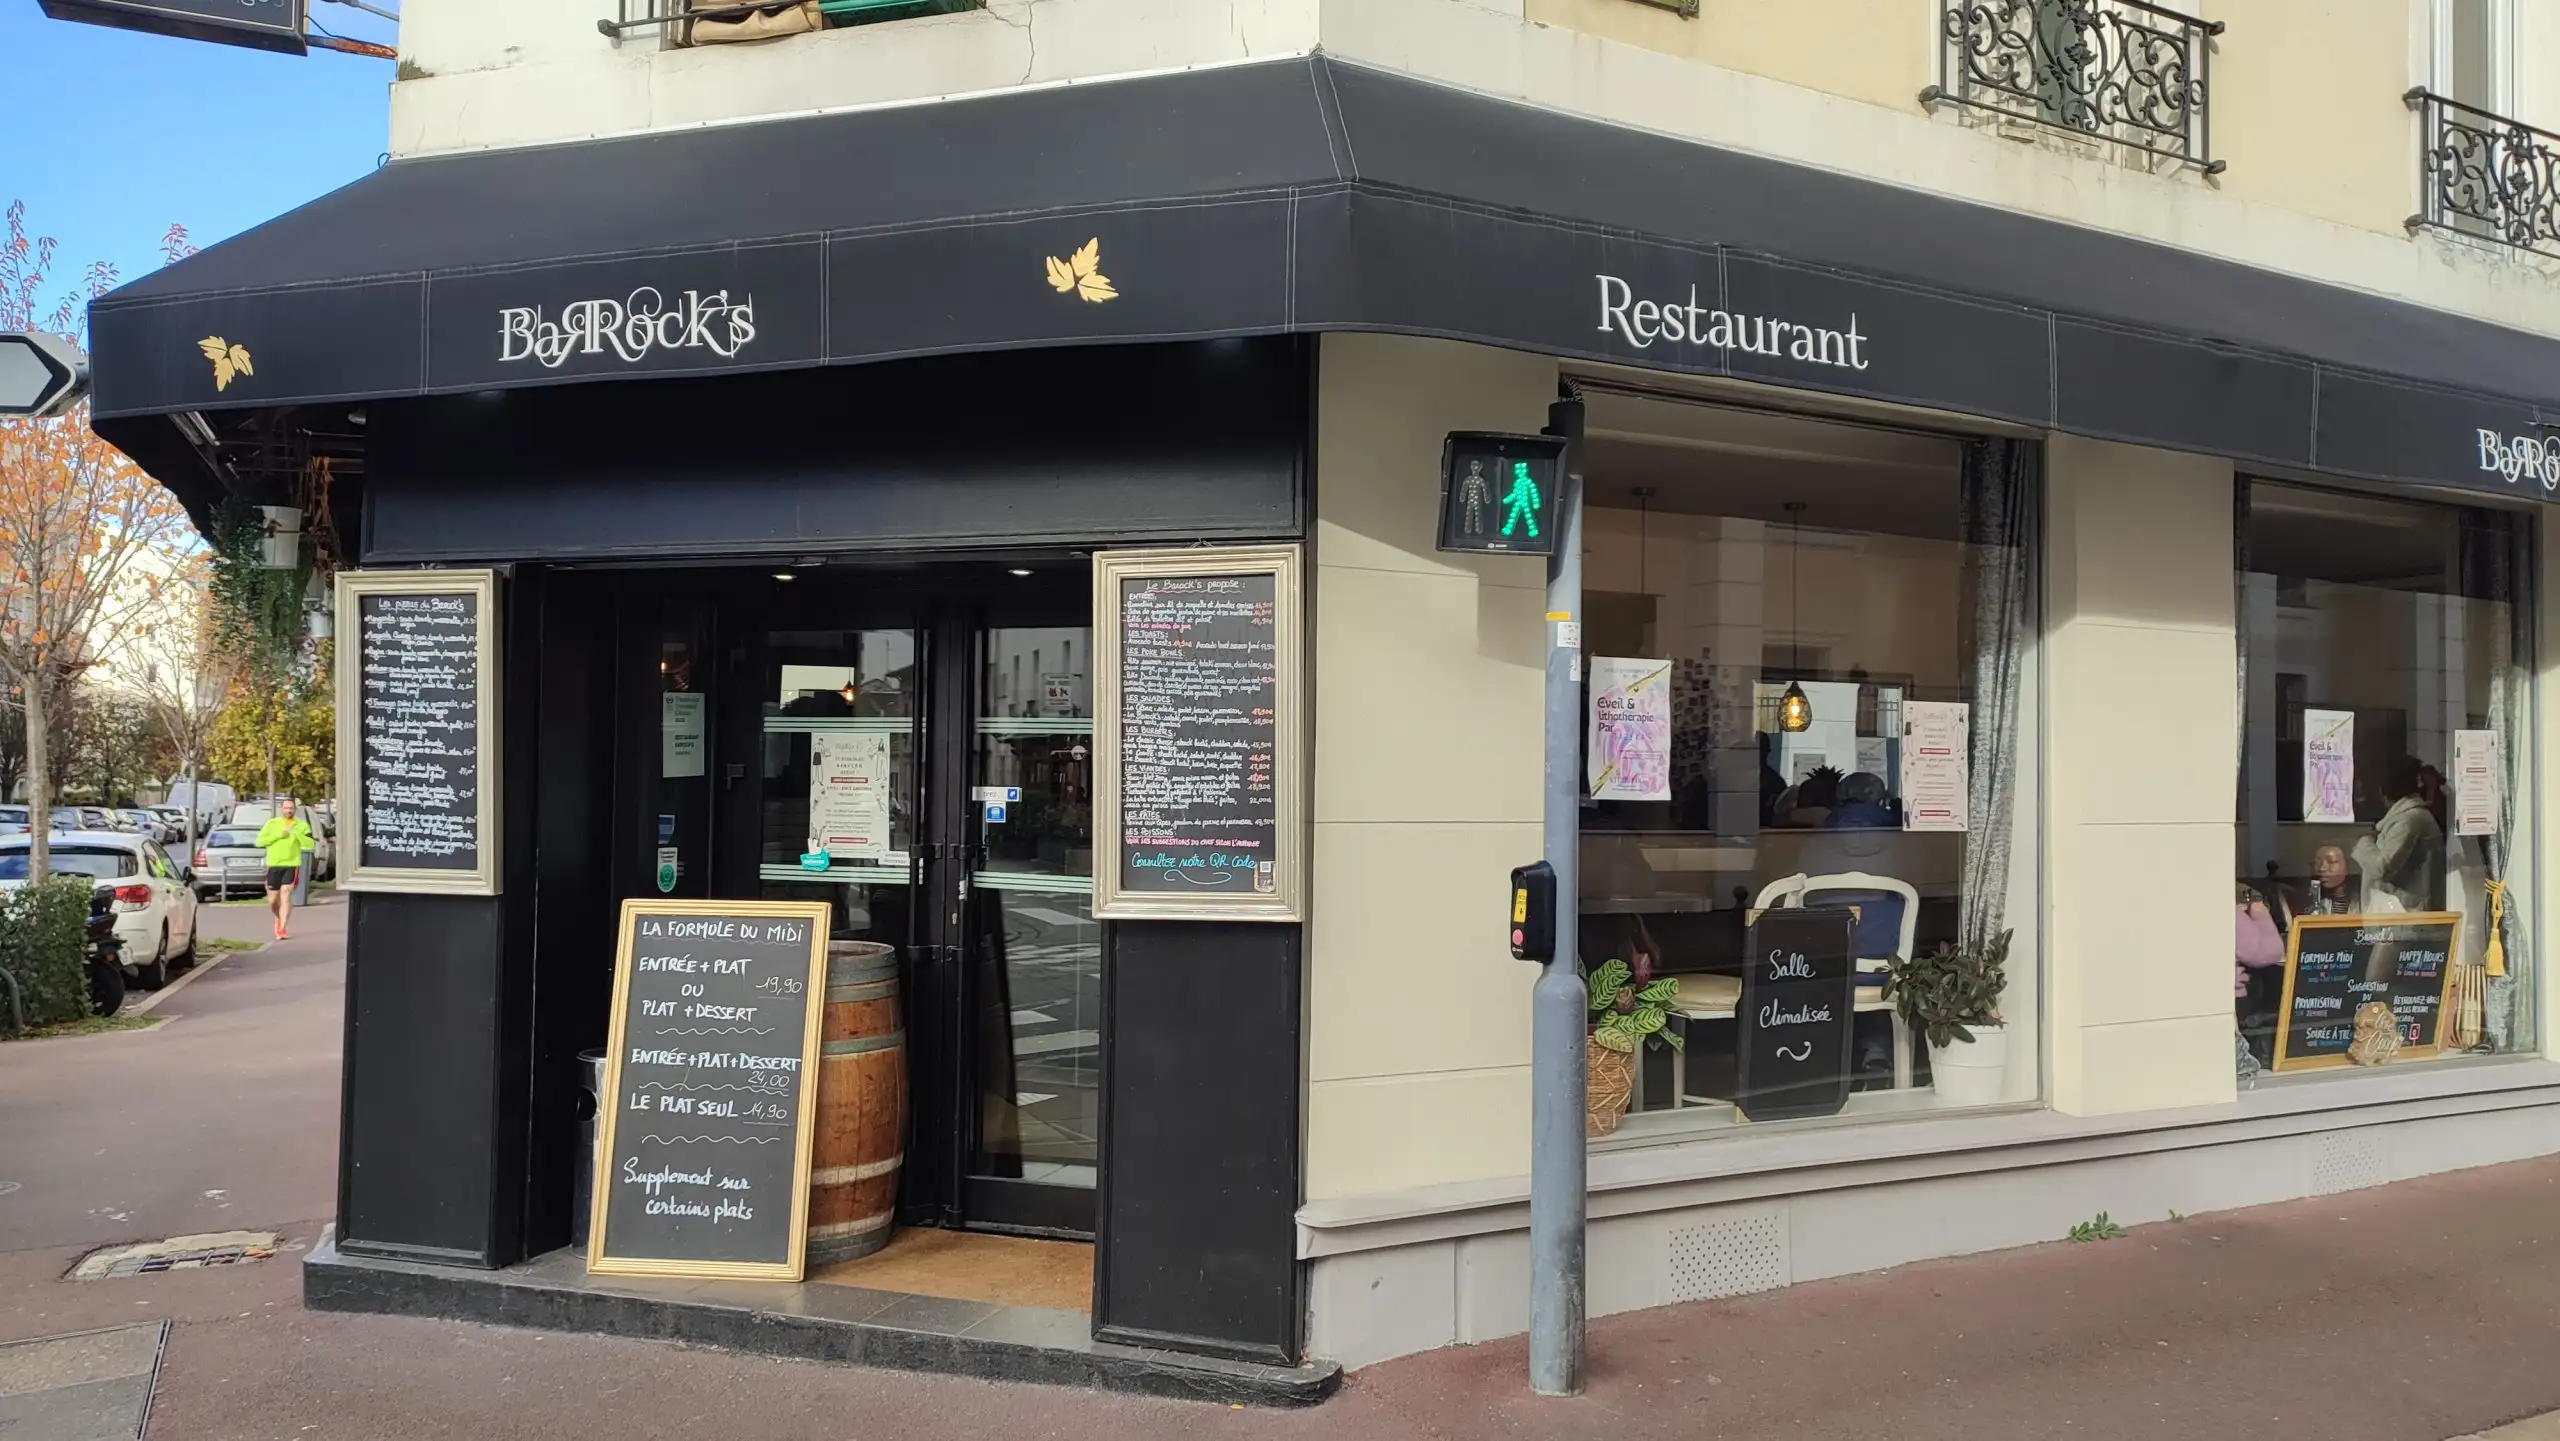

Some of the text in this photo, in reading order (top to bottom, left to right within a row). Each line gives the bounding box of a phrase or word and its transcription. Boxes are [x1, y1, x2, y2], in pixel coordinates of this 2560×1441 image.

[1595, 274, 1869, 370] Restaurant
[1178, 853, 1206, 868] notre
[1209, 852, 1230, 868] QR
[642, 920, 662, 937] LA
[667, 920, 735, 939] FORMULE
[740, 922, 758, 939] DU
[638, 953, 698, 973] ENTRÉE
[714, 958, 752, 976] PLAT
[1769, 949, 1816, 981] Salle
[681, 983, 704, 998] OU
[642, 1000, 677, 1017] PLAT
[1759, 998, 1833, 1029] Climatisée
[748, 1070, 790, 1087] 24,00
[630, 1092, 651, 1111] LE
[660, 1096, 696, 1114] PLAT
[697, 1100, 738, 1118] SEUL
[716, 1176, 751, 1190] sur
[714, 1198, 754, 1224] plats
